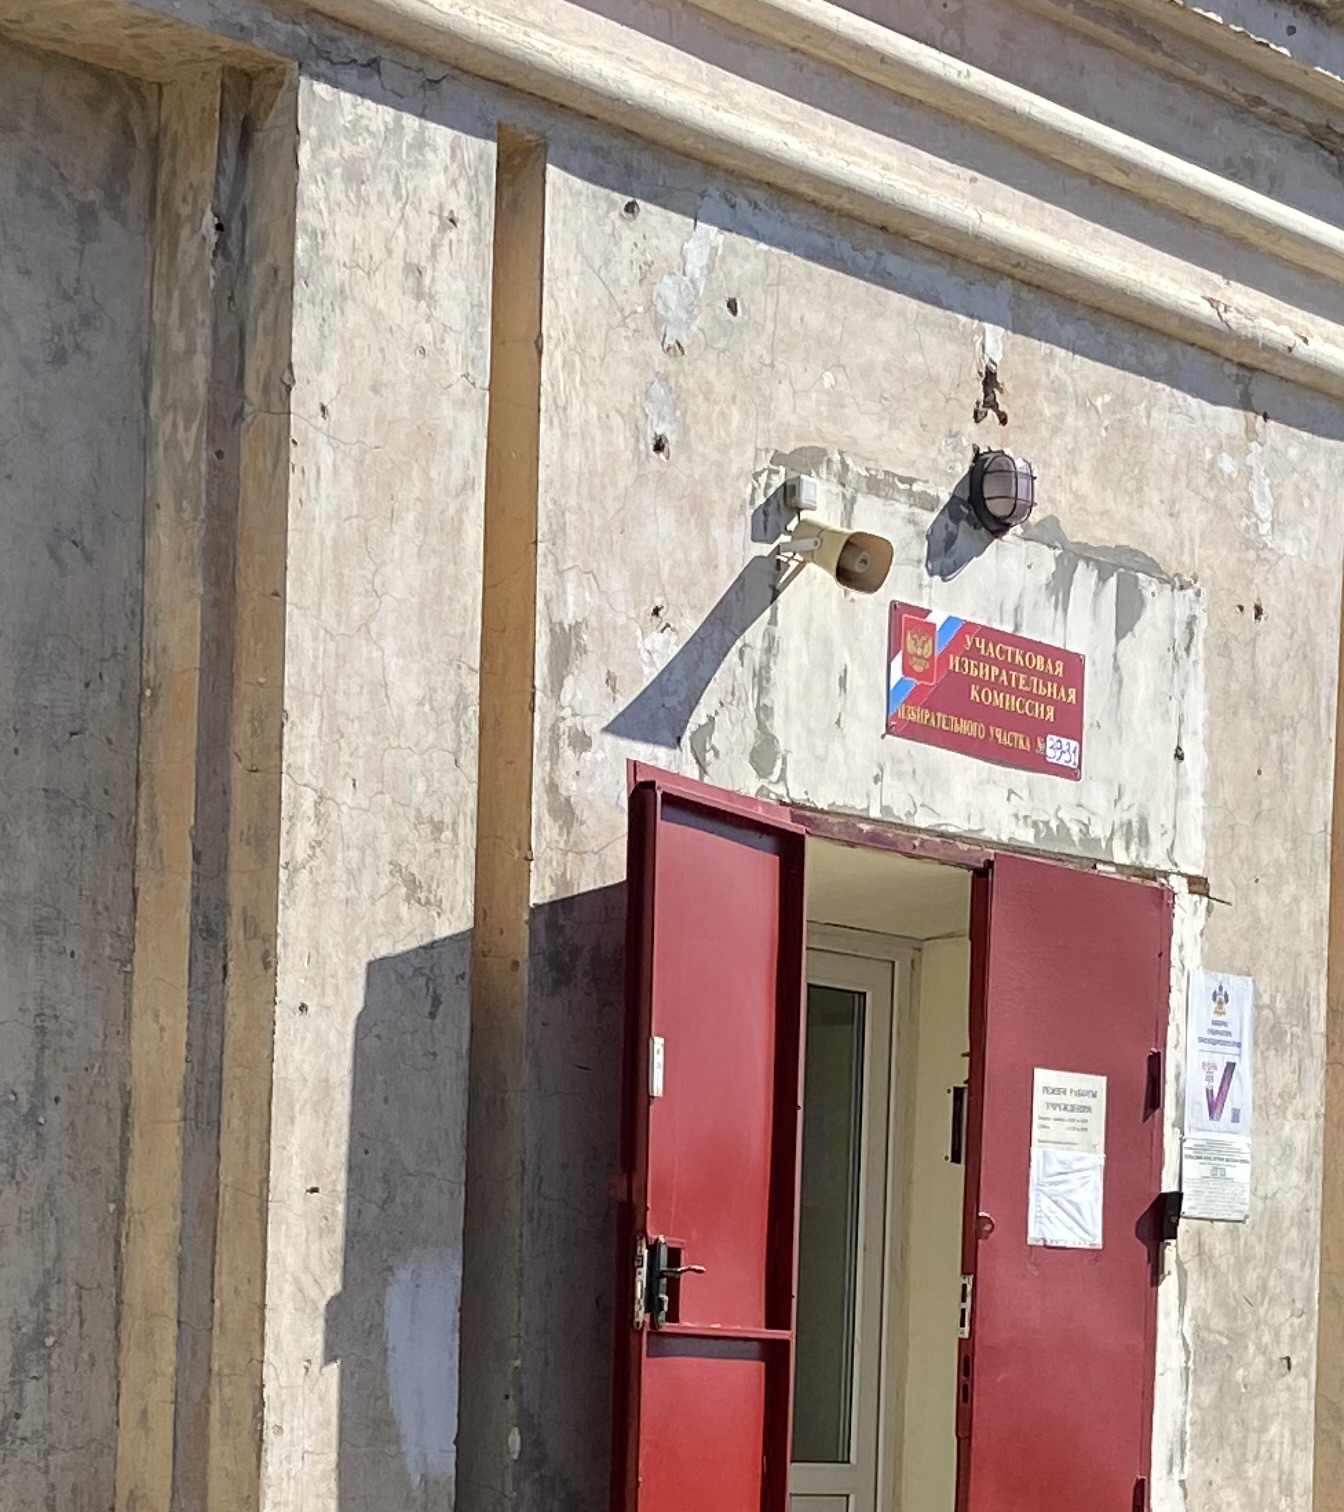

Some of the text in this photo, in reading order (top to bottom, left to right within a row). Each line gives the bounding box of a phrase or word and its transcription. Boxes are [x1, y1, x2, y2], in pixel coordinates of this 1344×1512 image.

[963, 634, 1064, 677] УЧАСТКОВАЯ
[949, 653, 1077, 705] ИЗБИРАТЕЛЬНАЯ
[970, 684, 1055, 722] КОМИССИЯ
[897, 705, 986, 740] ИЗБИРАТЕЛЬНОГО
[989, 725, 1031, 752] УЧАСТКА
